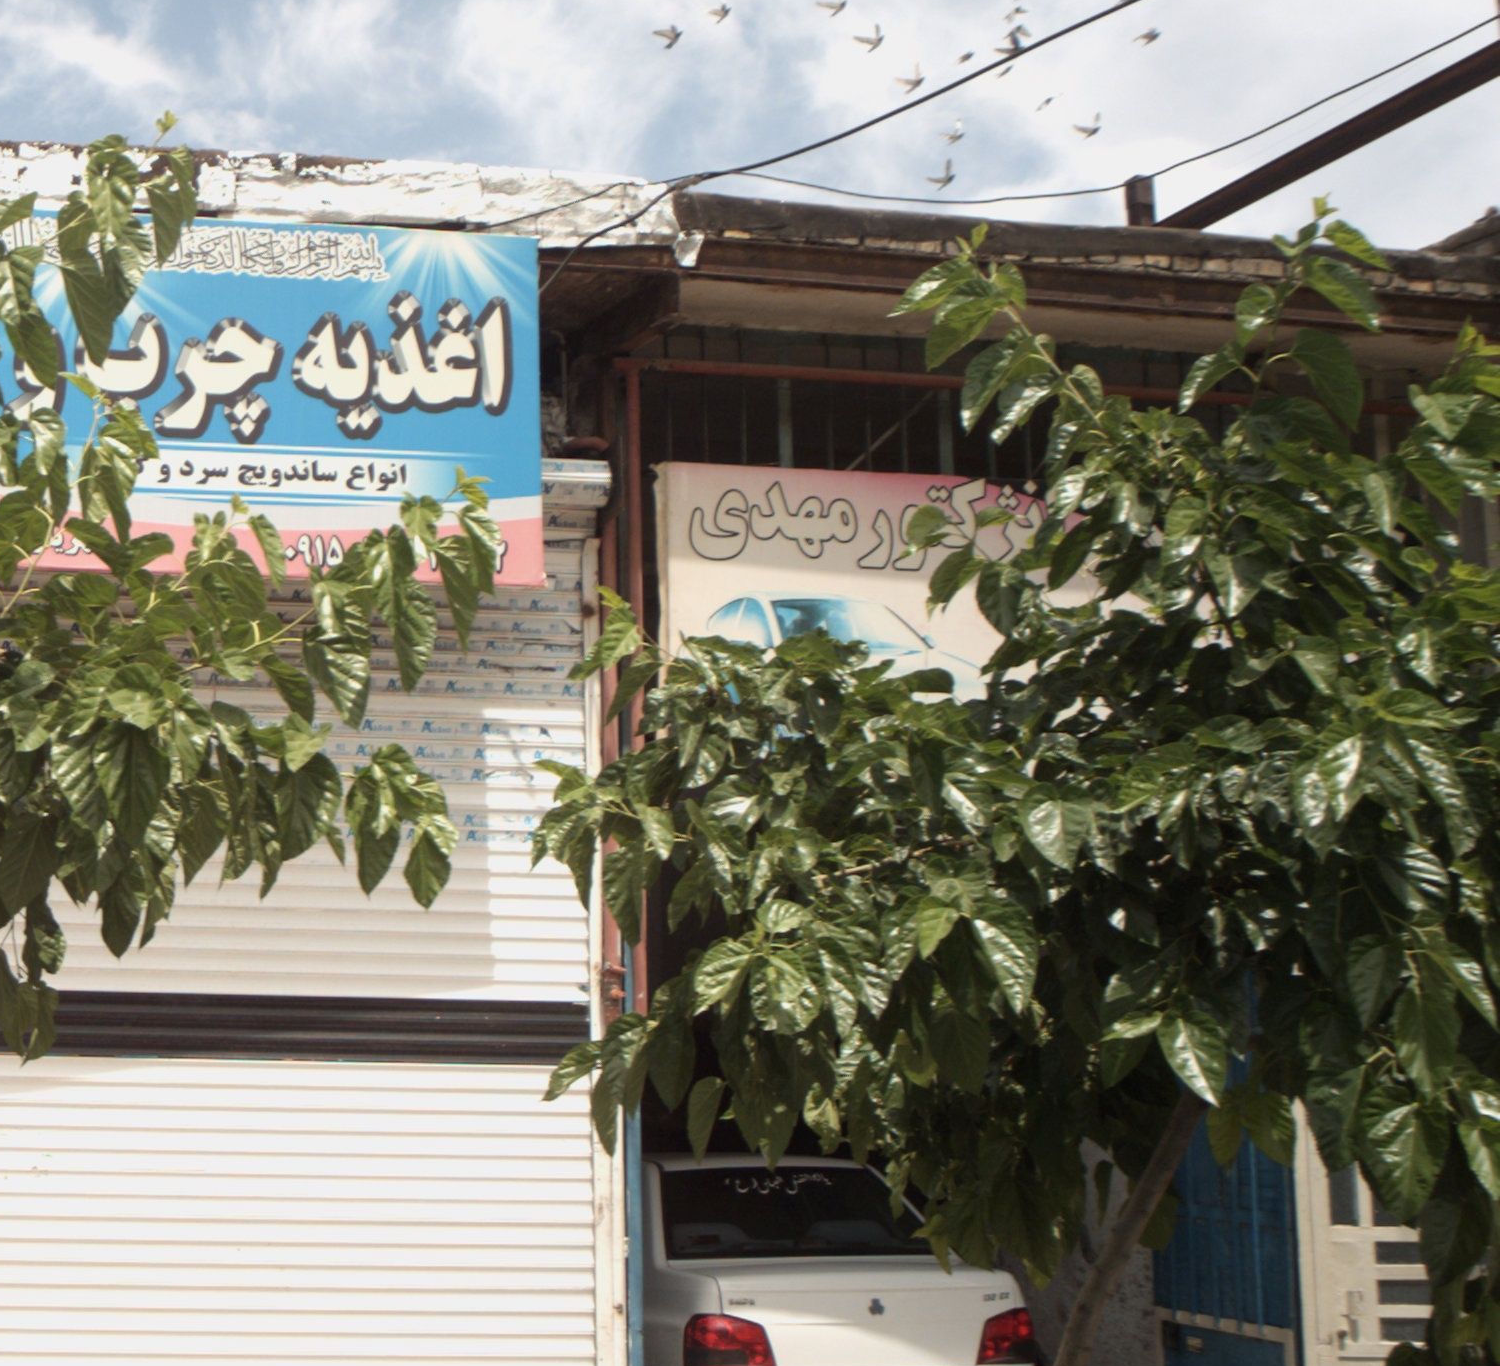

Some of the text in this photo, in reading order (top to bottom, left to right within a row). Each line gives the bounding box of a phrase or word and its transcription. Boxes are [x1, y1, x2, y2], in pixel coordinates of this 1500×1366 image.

[290, 289, 514, 441] اغذیه
[156, 462, 172, 484] و
[179, 458, 230, 486] سرد
[237, 458, 338, 488] ساندویچ
[344, 462, 408, 492] انواع
[688, 477, 1046, 573] نژکتور مهدی
